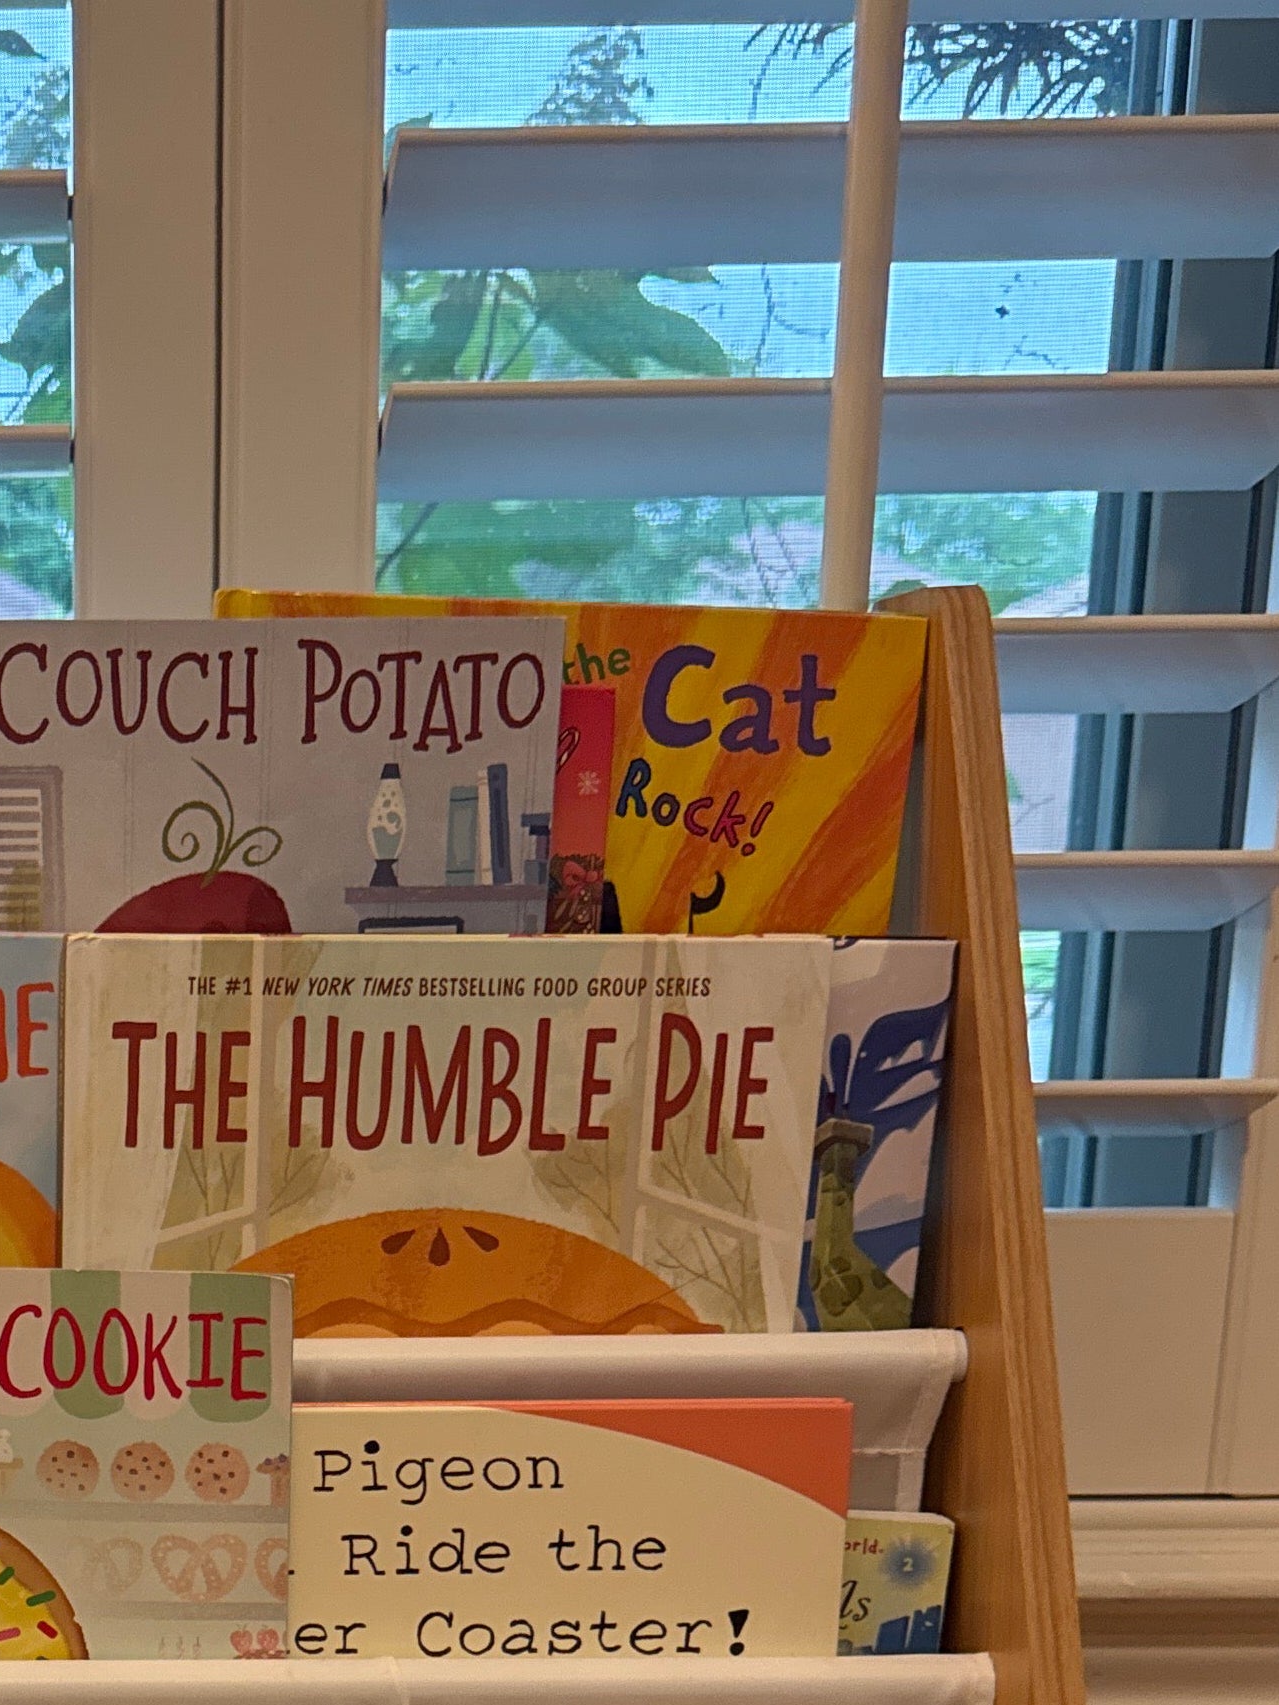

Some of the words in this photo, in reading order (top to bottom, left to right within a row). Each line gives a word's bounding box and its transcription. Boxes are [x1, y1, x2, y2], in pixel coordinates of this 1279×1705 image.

[298, 639, 546, 754] POTATO
[641, 644, 837, 757] Cat
[188, 976, 216, 996] THE
[225, 976, 253, 996] #1
[262, 976, 301, 996] NEW
[308, 976, 356, 997] YORK
[362, 977, 414, 997] TIMES
[418, 977, 525, 998] BESTSELLING
[534, 977, 579, 997] FOOD
[587, 977, 648, 997] GROUP
[656, 977, 711, 997] SERIES
[112, 1021, 252, 1150] THE
[288, 1015, 617, 1157] HUMBLE
[651, 1012, 775, 1156] PIE
[313, 1440, 564, 1505] Pigeon
[341, 1525, 511, 1576] Ride
[548, 1525, 667, 1572] the
[417, 1608, 751, 1658] Coaster!
